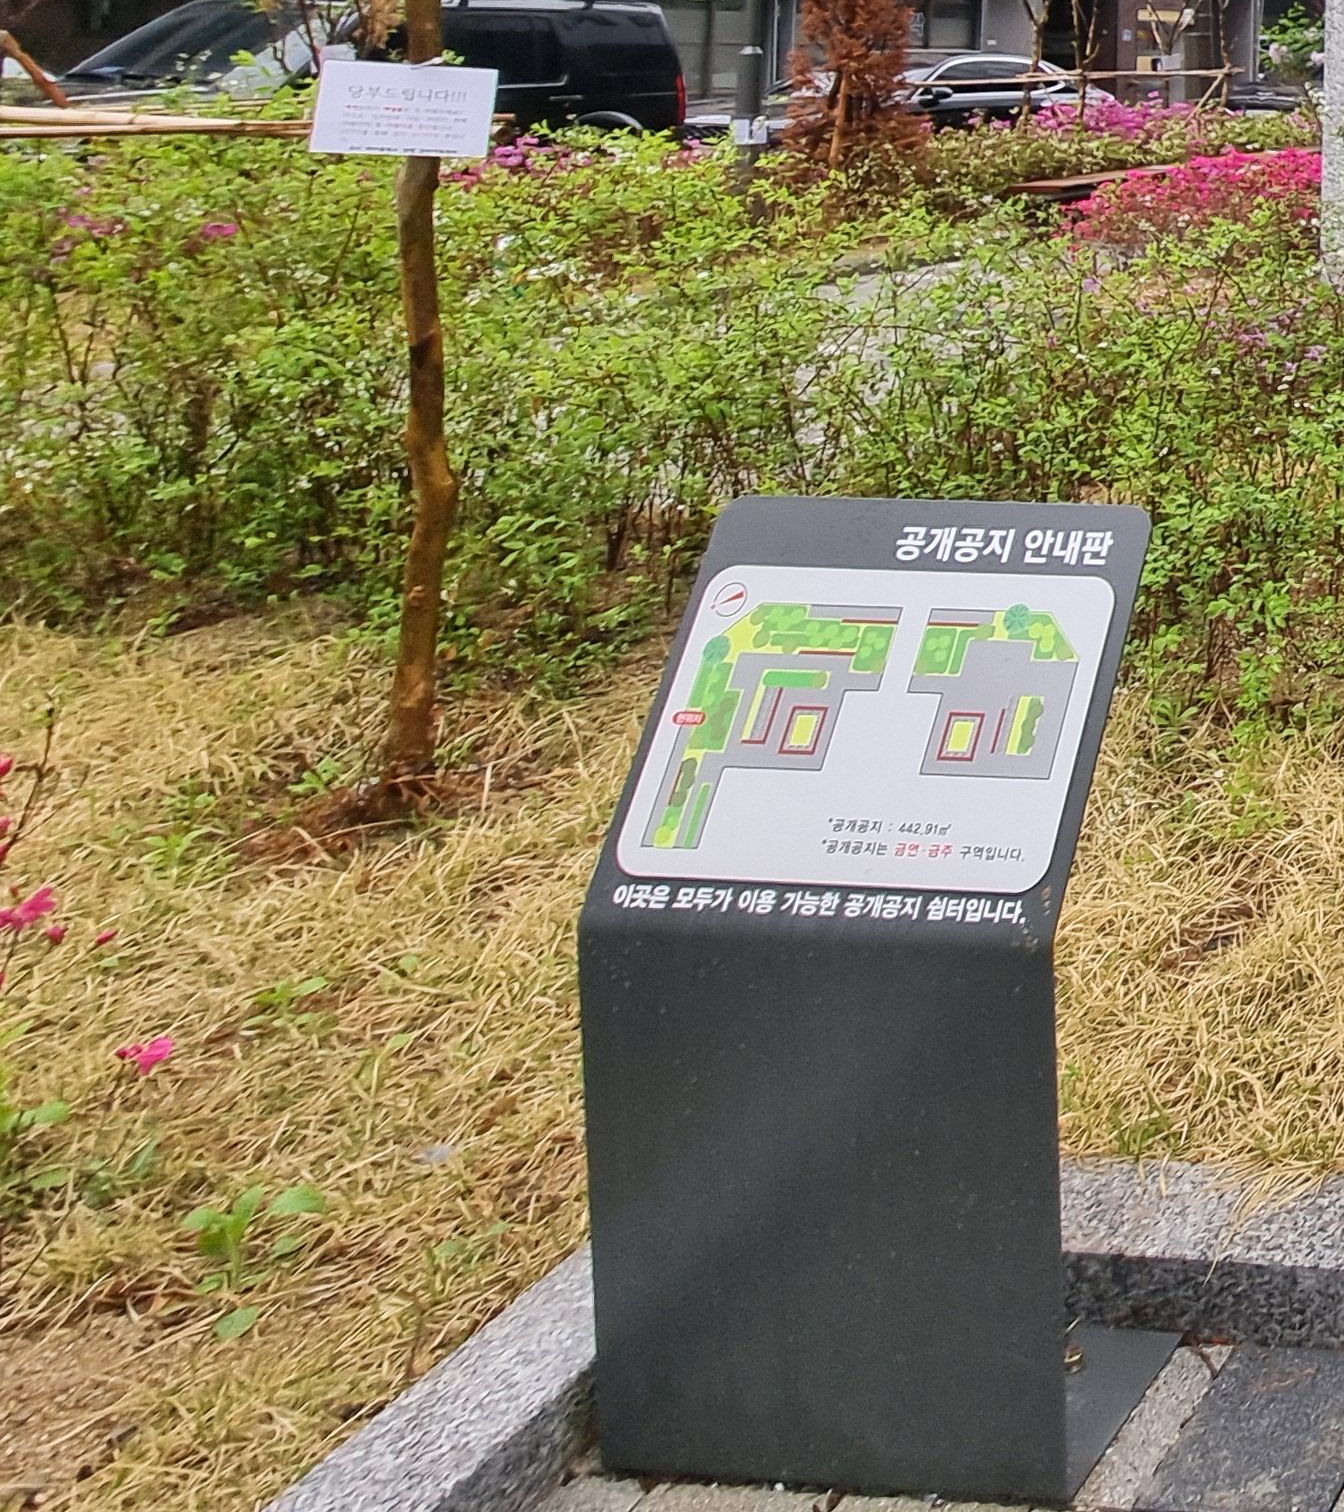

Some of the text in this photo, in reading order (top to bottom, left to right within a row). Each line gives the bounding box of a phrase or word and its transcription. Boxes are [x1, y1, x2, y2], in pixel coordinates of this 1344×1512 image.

[894, 525, 1115, 566] 공개공지 안내판
[959, 845, 1026, 862] 구역입니다.
[612, 883, 1028, 925] 이곳은 모두가 이용 가능한 공개공지 쉼터입니다.
